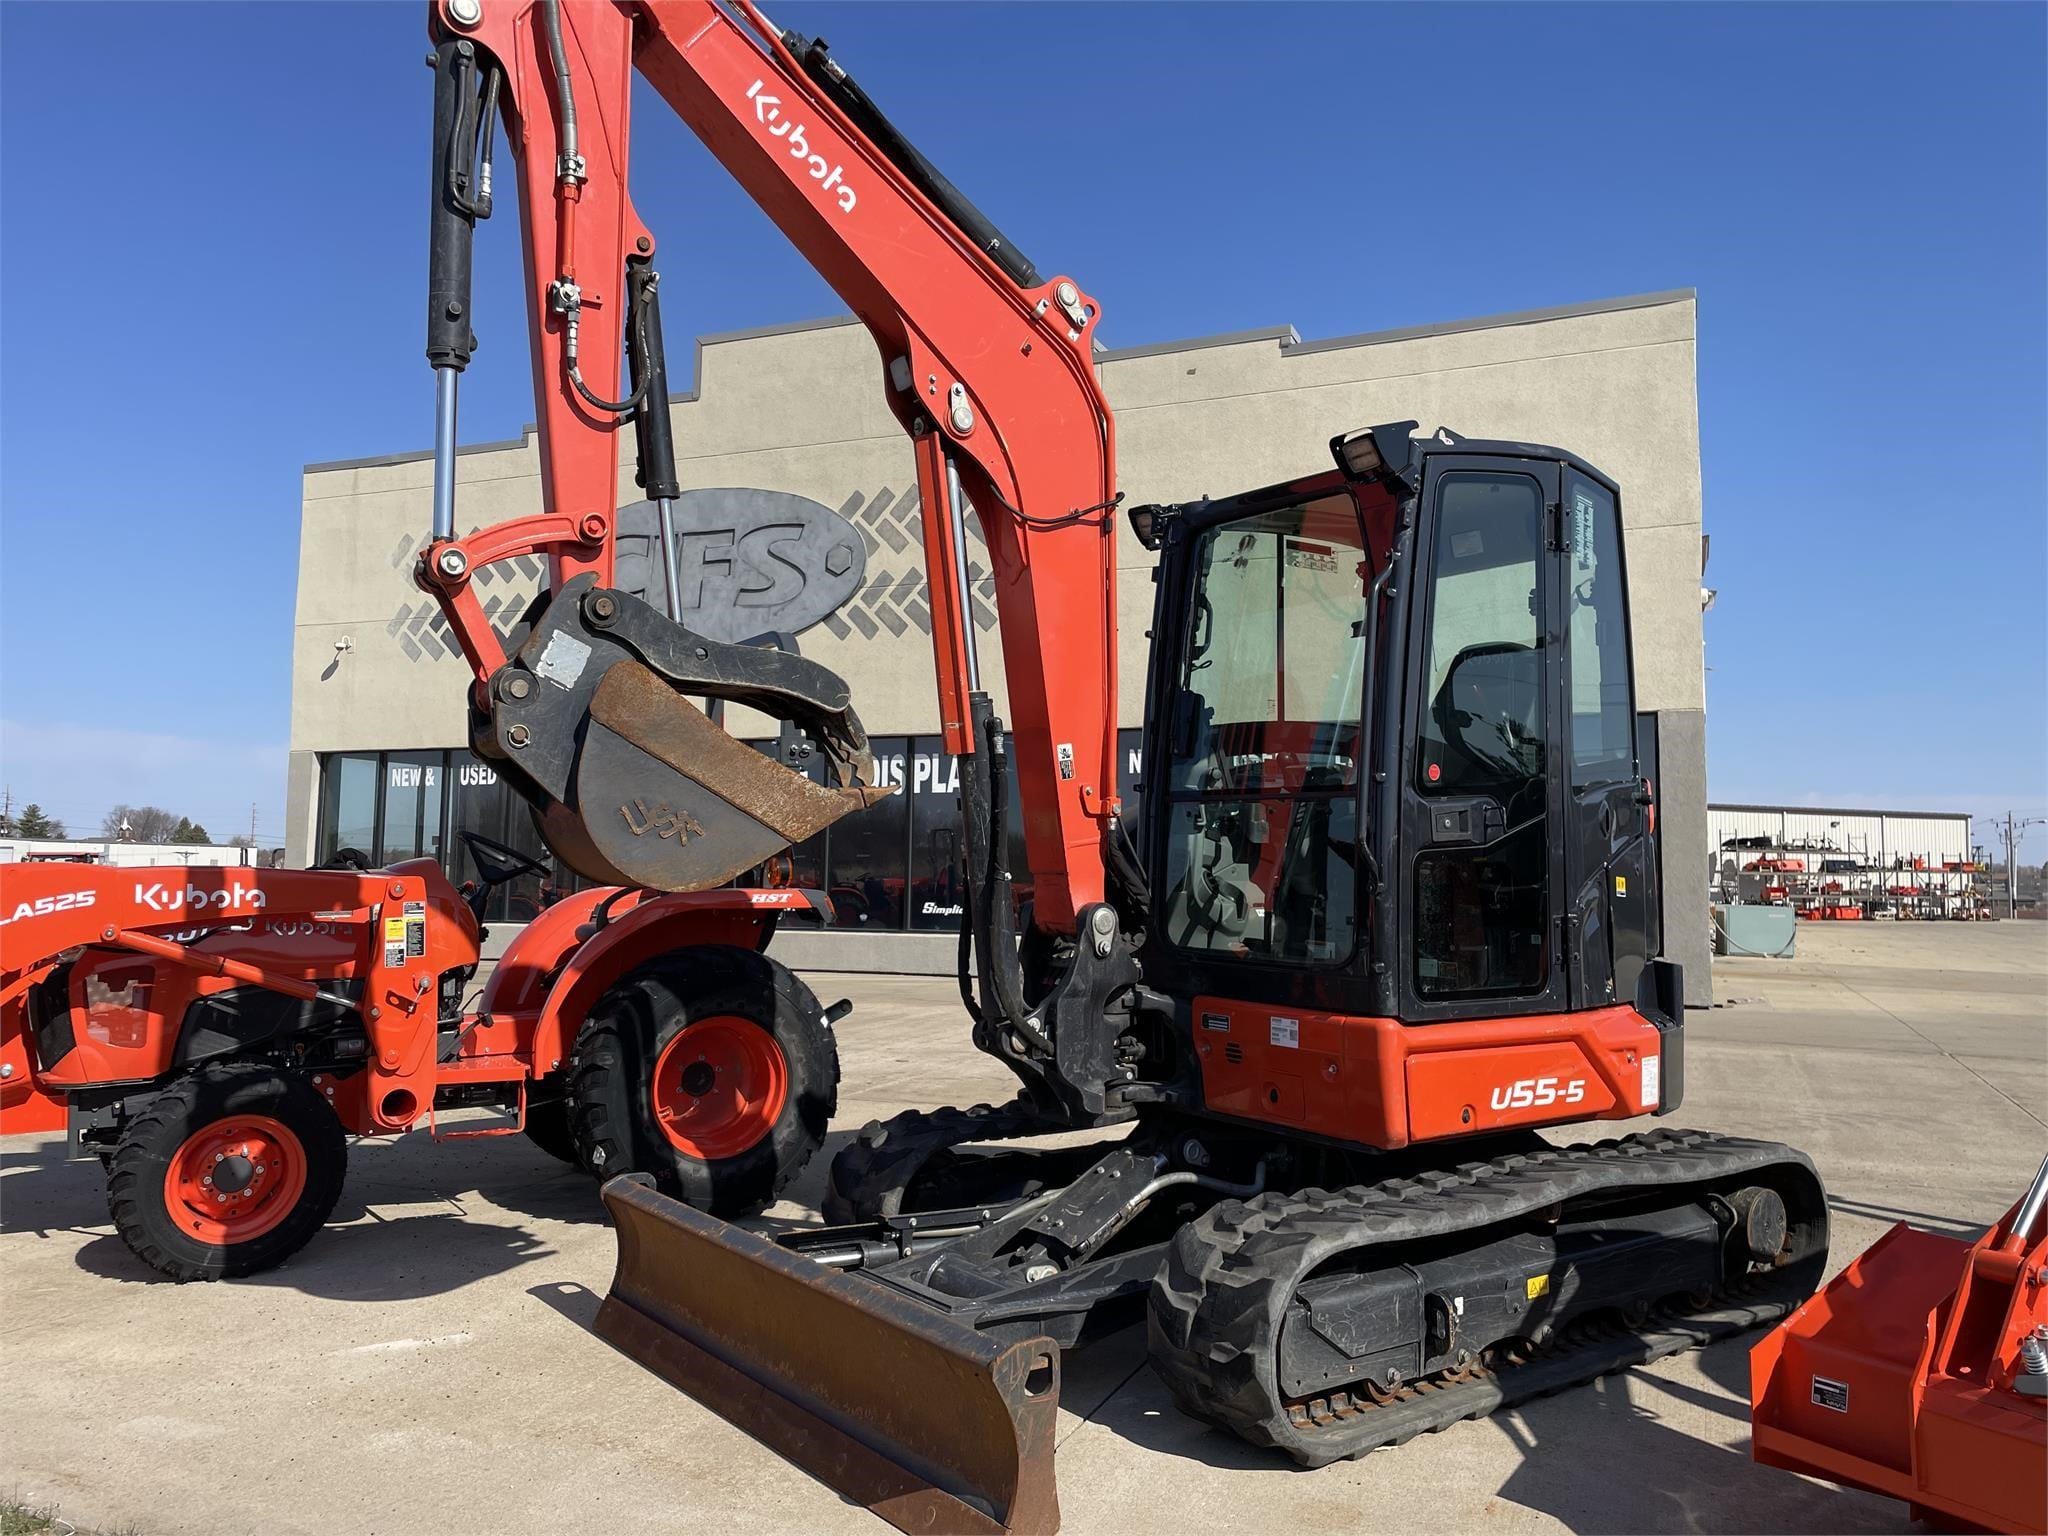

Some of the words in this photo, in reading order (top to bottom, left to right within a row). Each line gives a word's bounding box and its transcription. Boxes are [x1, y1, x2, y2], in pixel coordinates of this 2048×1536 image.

[746, 79, 857, 213] Kubota
[392, 767, 422, 787] NEW
[425, 767, 435, 786] &
[460, 764, 497, 786] USED
[135, 882, 267, 911] Kubota
[751, 893, 793, 903] HST
